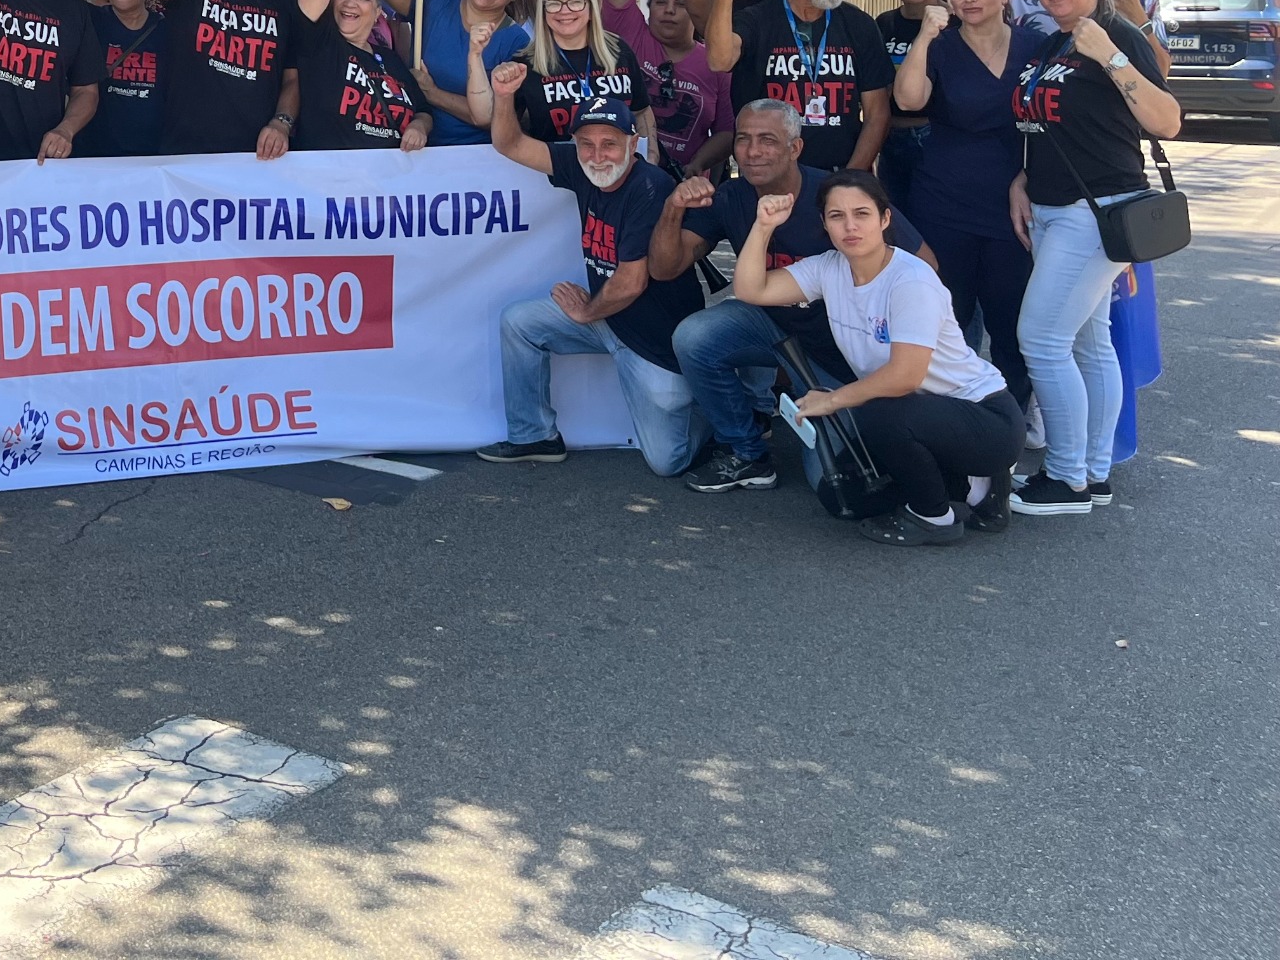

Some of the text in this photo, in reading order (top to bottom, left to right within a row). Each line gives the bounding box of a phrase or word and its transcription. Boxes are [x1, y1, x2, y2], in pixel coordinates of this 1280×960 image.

[23, 21, 60, 47] SUA
[241, 12, 278, 37] SUA
[196, 22, 277, 72] PARTE
[1167, 39, 1195, 48] 6F02
[1212, 44, 1236, 54] 153
[213, 60, 245, 76] SINSAÚDE
[818, 54, 856, 77] SUA
[1171, 55, 1230, 64] MUNICIPAL
[106, 66, 157, 83] ENTE
[595, 75, 632, 95] SUA
[78, 202, 130, 250] DO
[138, 197, 316, 247] HOSPITAL
[324, 189, 530, 240] MUNICIPAL
[126, 271, 364, 350] SOCORRO
[55, 385, 317, 452] SINSAÚDE
[95, 444, 276, 474] CAMPINAS E REGIÃO
